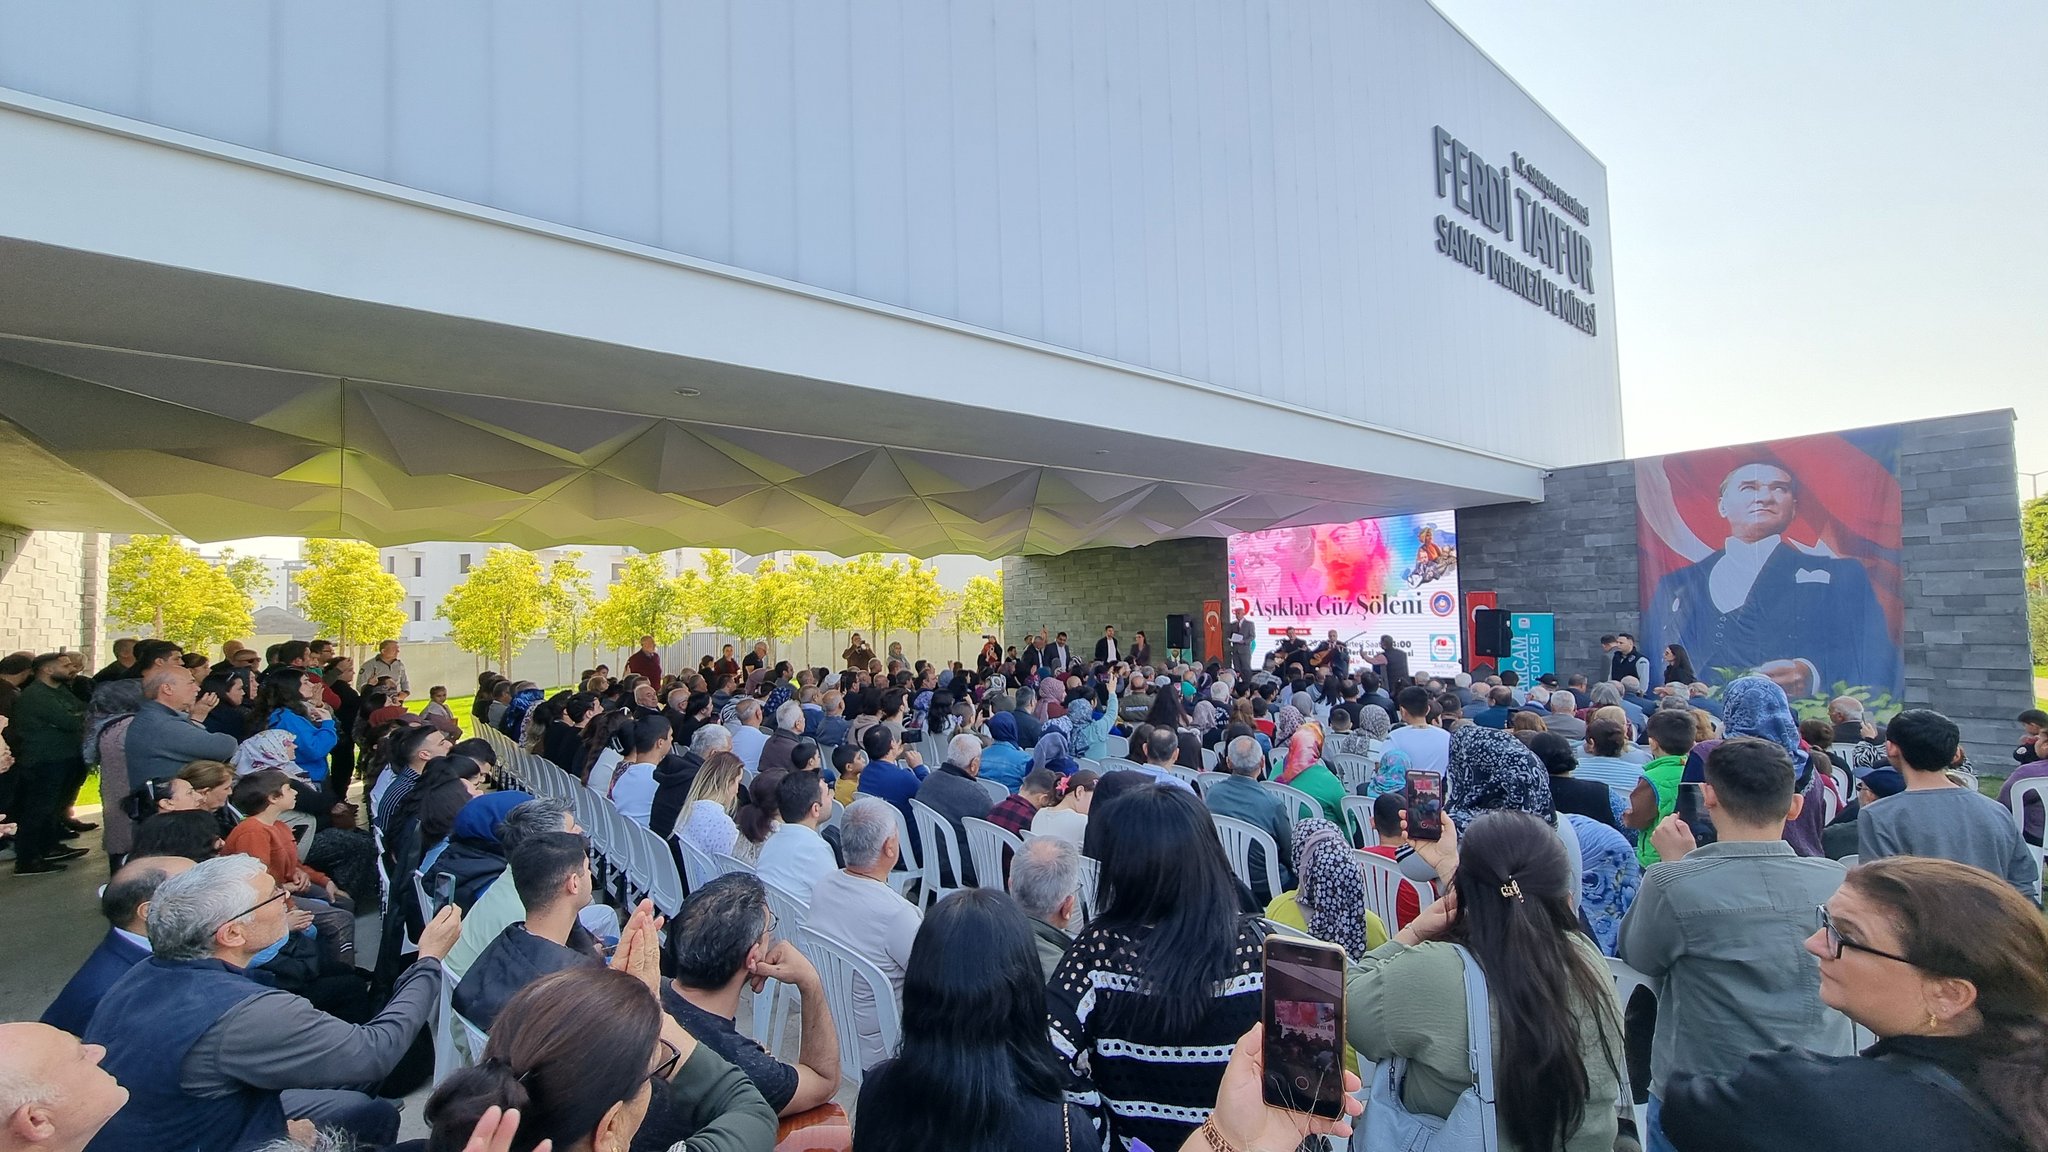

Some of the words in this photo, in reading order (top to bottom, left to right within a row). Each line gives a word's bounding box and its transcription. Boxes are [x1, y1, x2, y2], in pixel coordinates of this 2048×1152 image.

[1434, 125, 1514, 241] FERDİ
[1515, 187, 1595, 294] TAYFUR
[1435, 214, 1487, 275] SANAT
[1488, 244, 1544, 307] MERKEZİ
[1542, 278, 1559, 316] VE
[1558, 289, 1597, 337] MÜZESİ
[1316, 594, 1354, 616] Güz
[1356, 592, 1423, 620] Şöleni
[1392, 640, 1411, 648] 4:00
